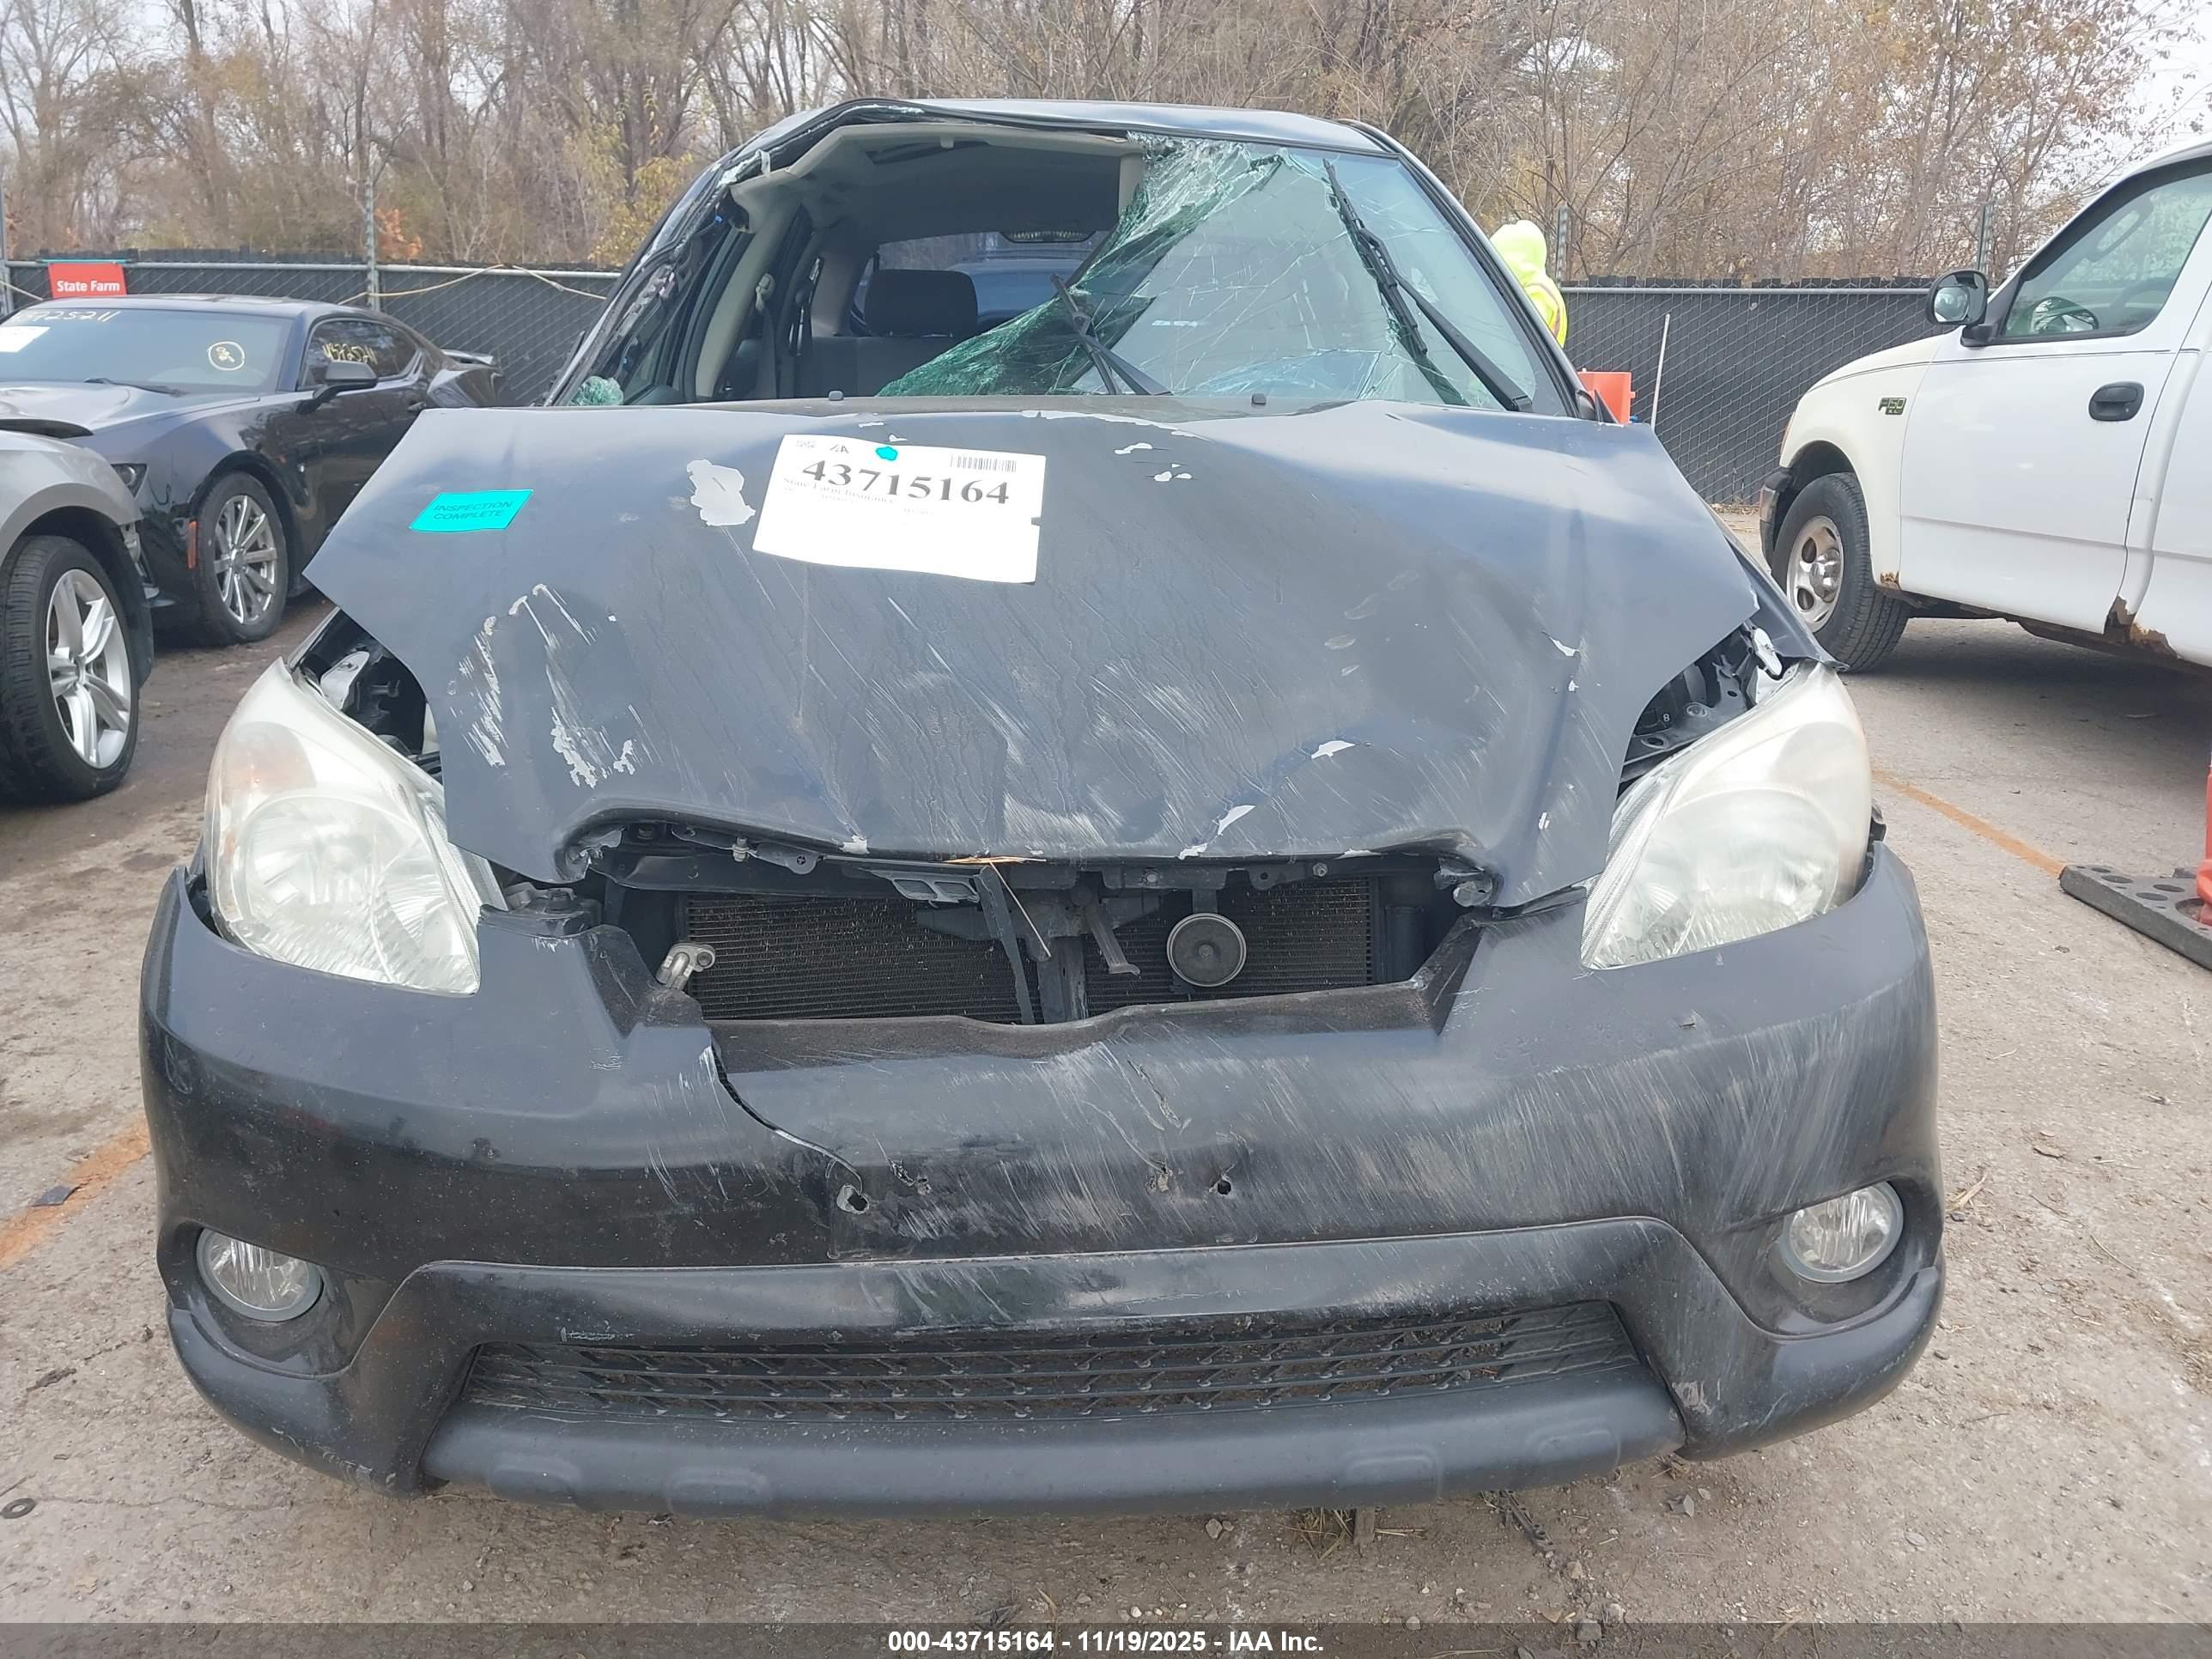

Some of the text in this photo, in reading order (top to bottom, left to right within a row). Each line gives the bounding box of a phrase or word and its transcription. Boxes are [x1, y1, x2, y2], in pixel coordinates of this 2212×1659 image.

[57, 281, 120, 292] State Farm
[802, 459, 1009, 504] 43715164
[433, 501, 514, 512] INSPECTION
[433, 509, 502, 520] COMPLETE
